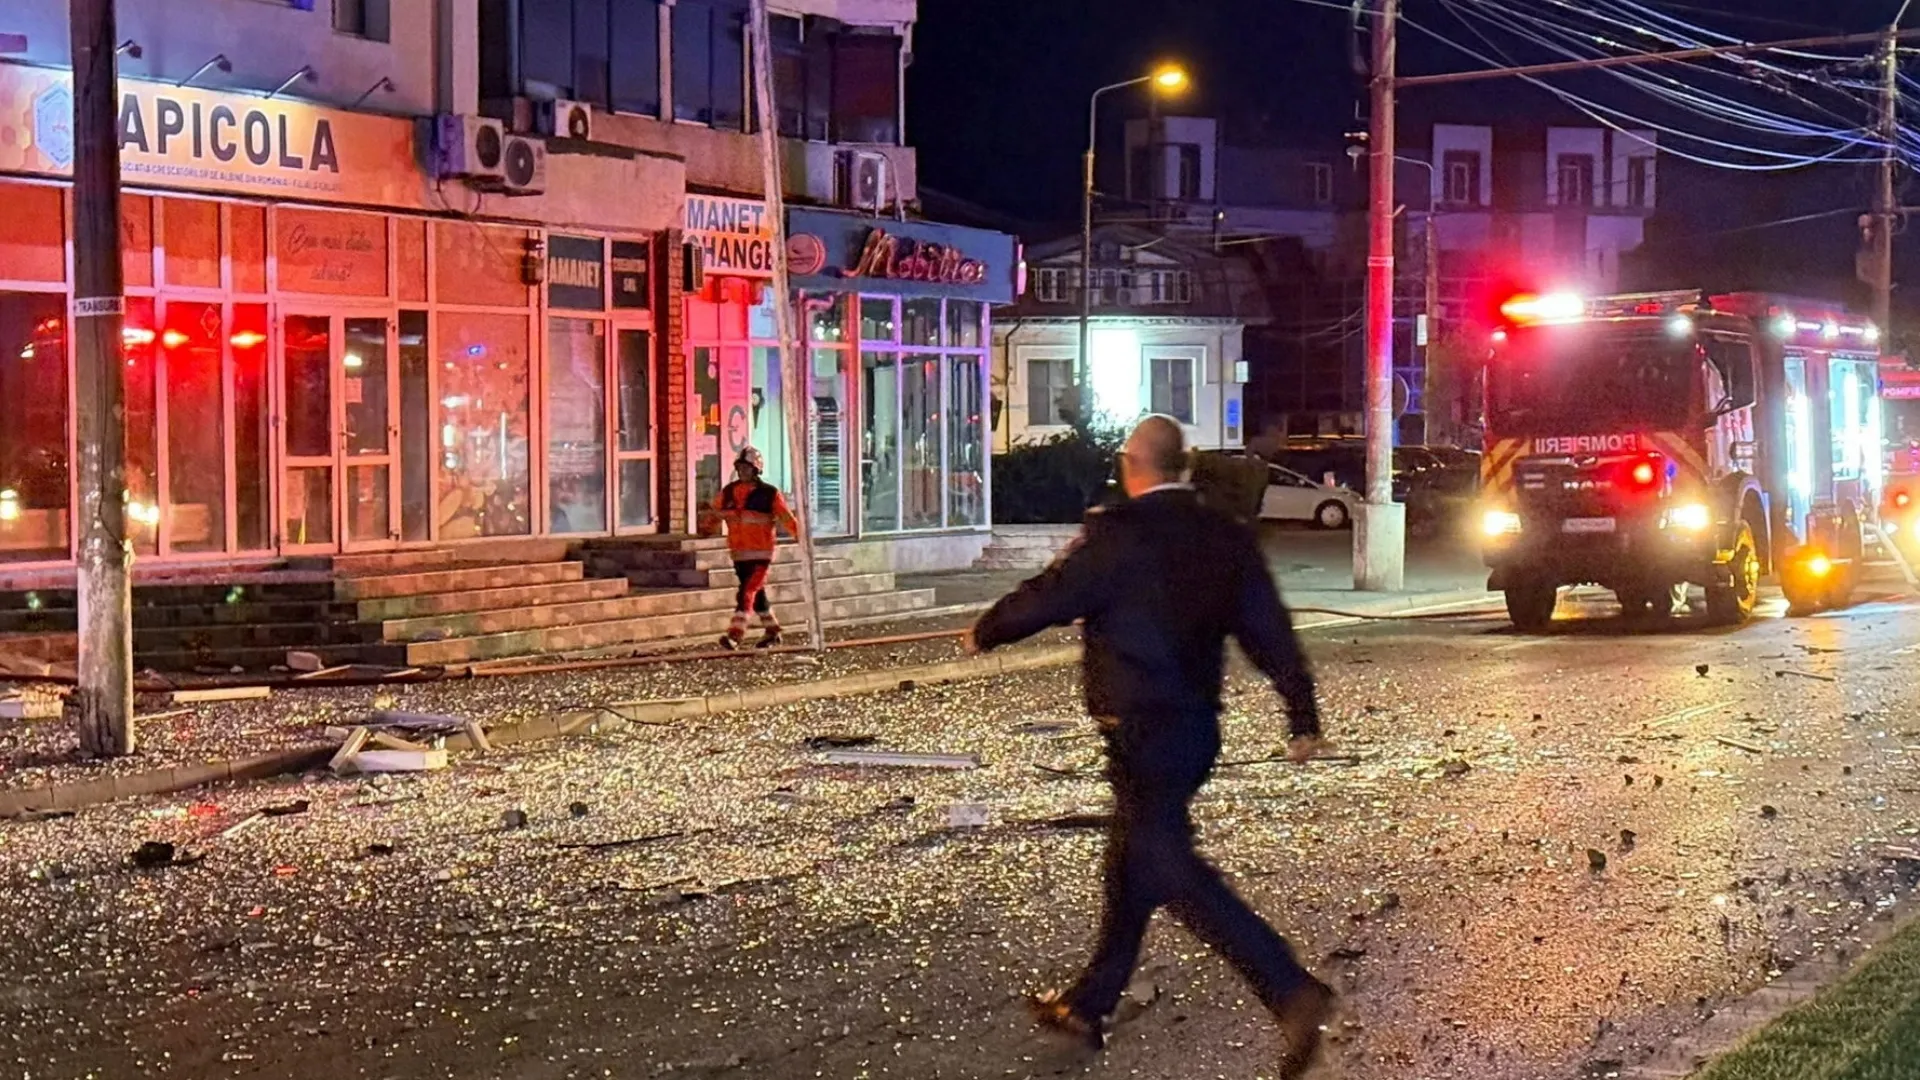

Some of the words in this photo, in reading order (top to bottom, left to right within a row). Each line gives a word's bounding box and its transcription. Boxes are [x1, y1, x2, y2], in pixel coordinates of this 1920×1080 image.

[118, 93, 340, 173] APICOLA
[687, 198, 764, 235] MANET
[684, 235, 773, 271] HANGE
[550, 256, 601, 288] AMANET
